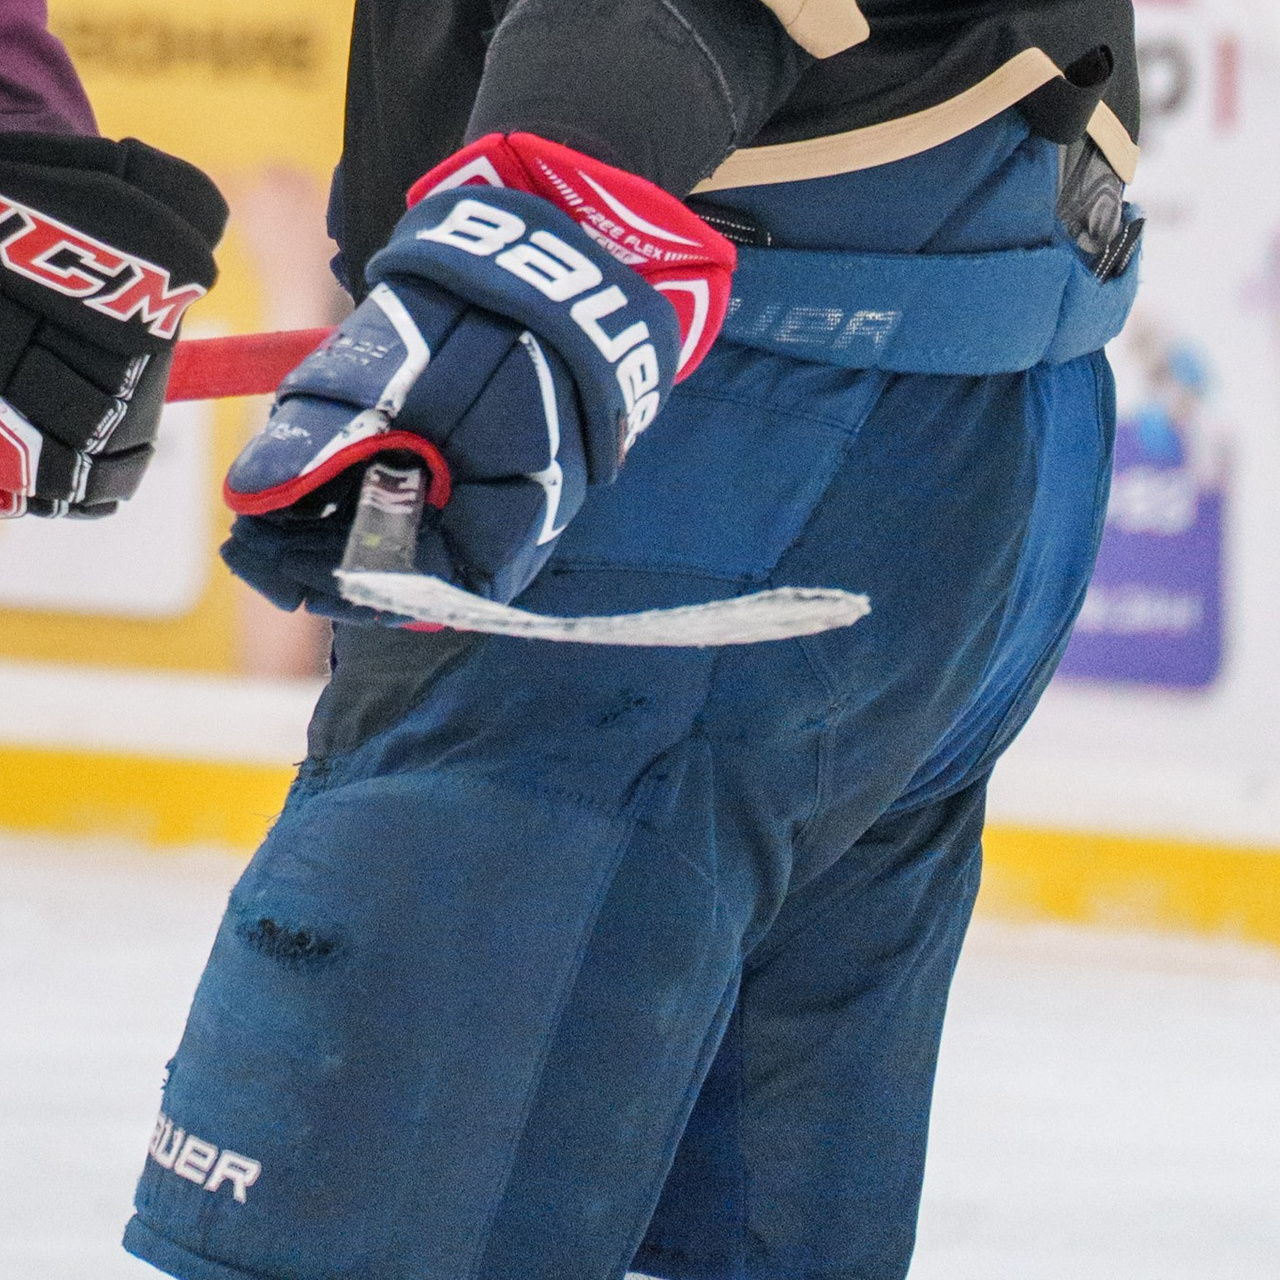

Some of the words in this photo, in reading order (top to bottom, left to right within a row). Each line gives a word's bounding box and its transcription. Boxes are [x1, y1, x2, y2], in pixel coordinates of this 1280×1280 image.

[576, 206, 625, 240] FREE
[623, 235, 664, 261] FLEX
[416, 198, 660, 454] BAUER
